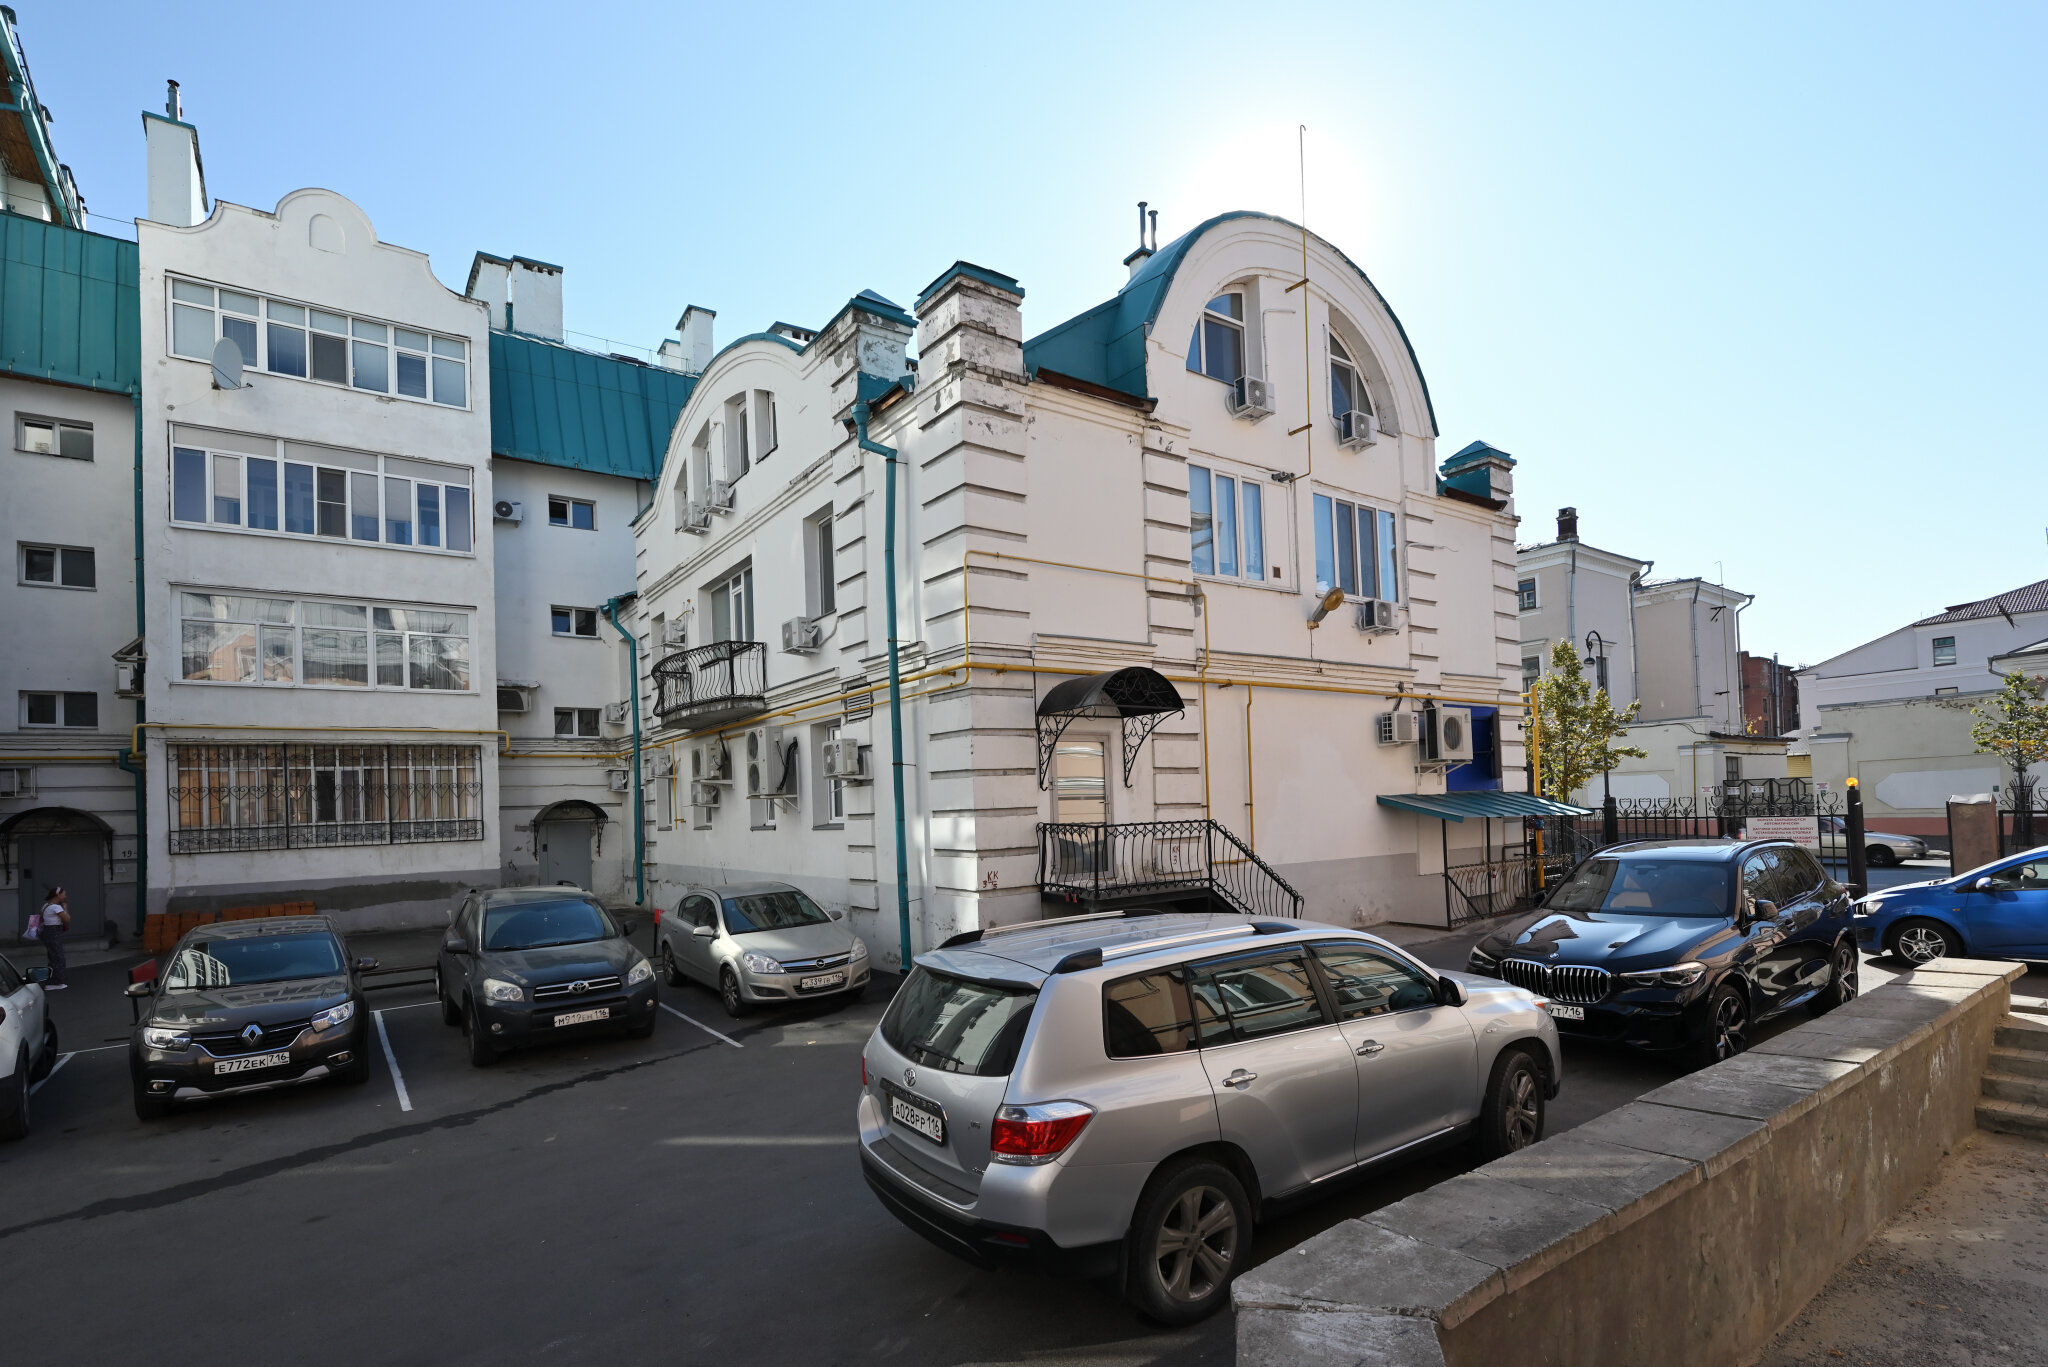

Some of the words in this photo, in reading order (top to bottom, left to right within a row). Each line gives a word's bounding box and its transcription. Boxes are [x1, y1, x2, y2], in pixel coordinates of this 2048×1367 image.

[1563, 1006, 1581, 1015] 716
[219, 1058, 266, 1073] Е772ЕК
[269, 1053, 287, 1063] 716
[927, 1115, 940, 1133] 116
